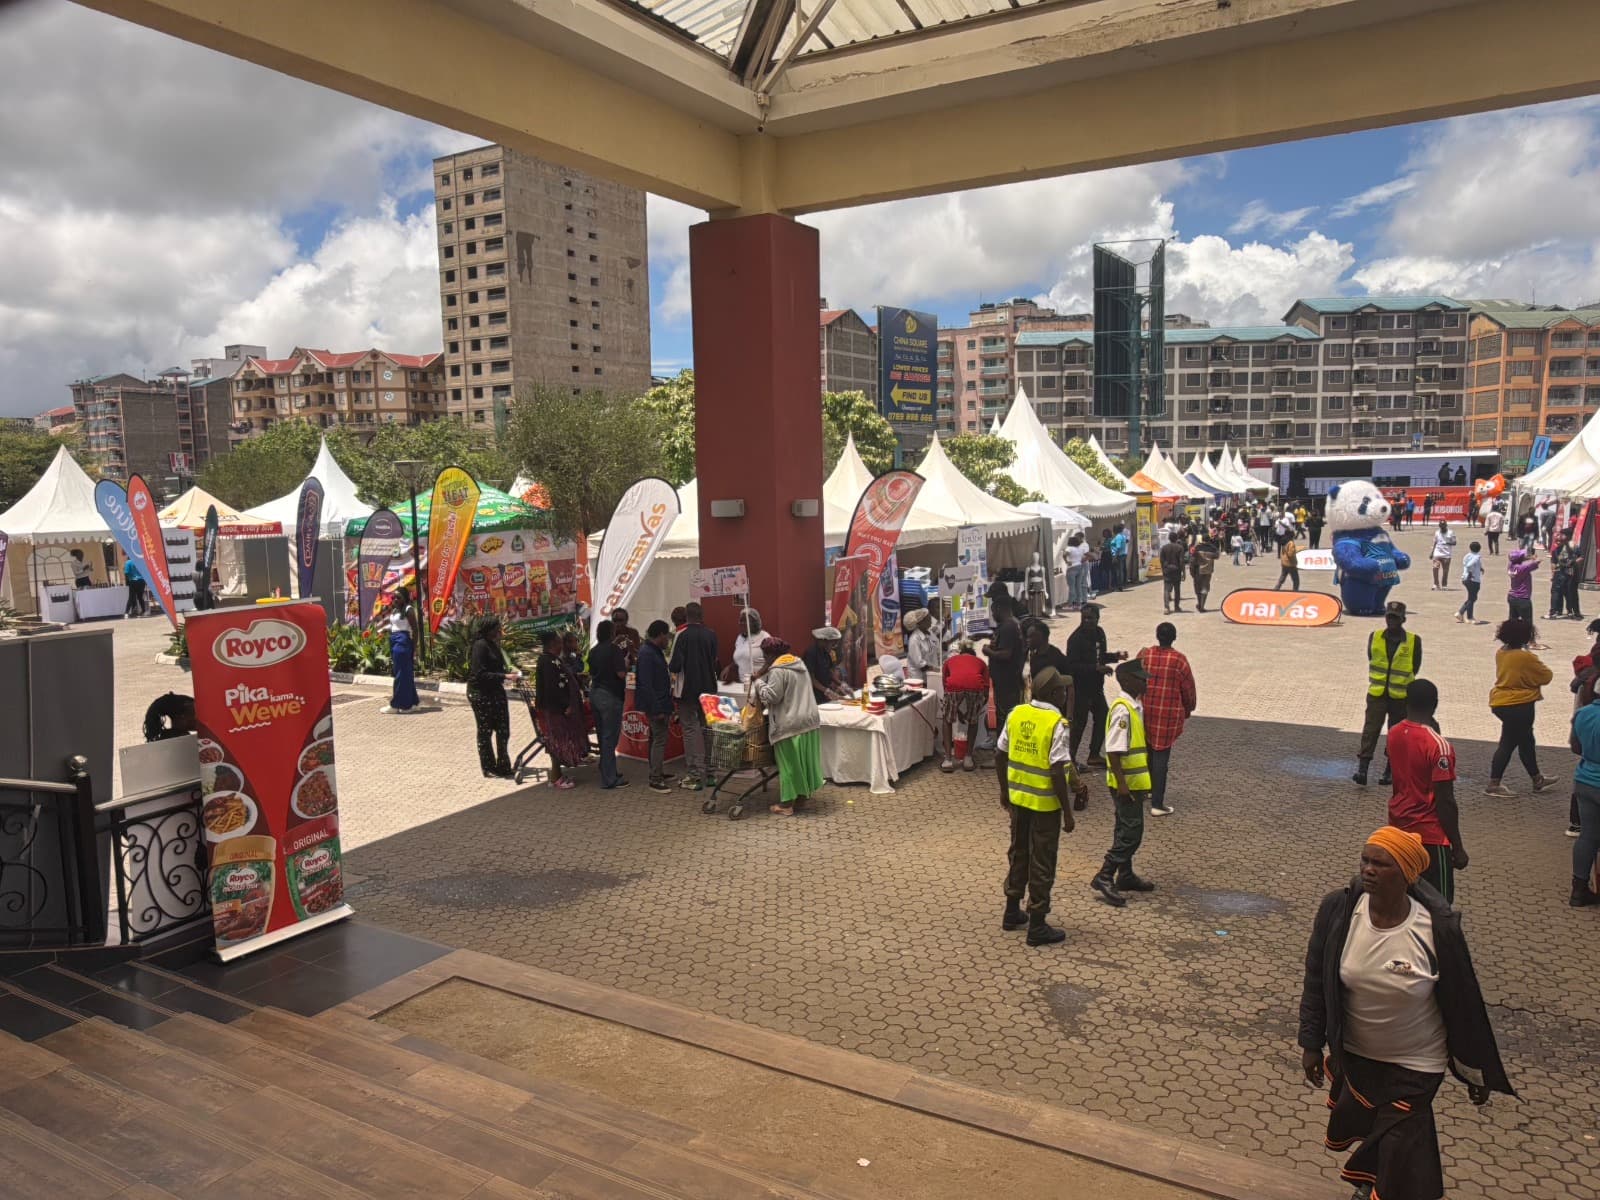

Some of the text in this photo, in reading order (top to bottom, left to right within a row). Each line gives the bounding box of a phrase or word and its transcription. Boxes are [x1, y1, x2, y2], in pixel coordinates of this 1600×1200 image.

[902, 391, 928, 401] FIND US
[1239, 597, 1320, 620] naivas
[225, 635, 293, 659] Royco
[225, 683, 295, 707] Pika kama
[230, 701, 302, 726] Wewe
[1014, 745, 1039, 756] SECURITY
[1015, 738, 1037, 748] PRIVATE
[293, 829, 330, 850] ORIGINAL
[304, 852, 329, 868] Royco
[229, 873, 255, 884] Royco
